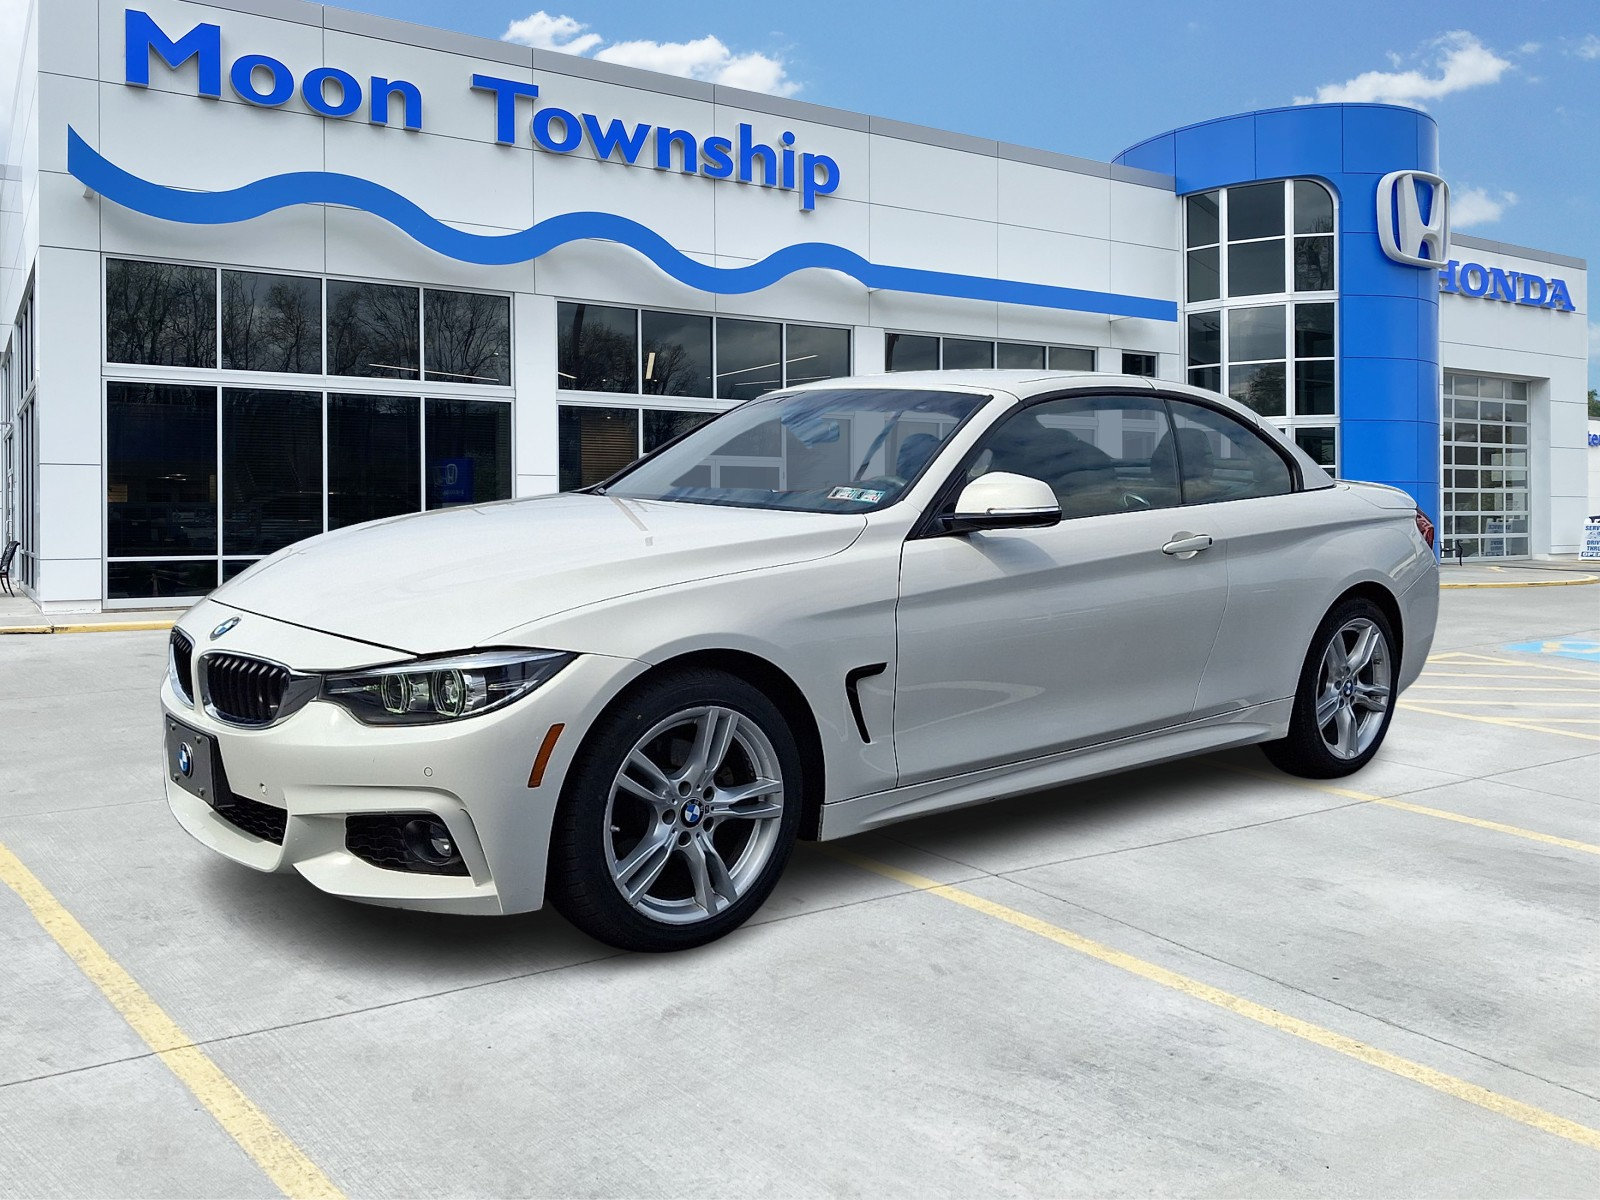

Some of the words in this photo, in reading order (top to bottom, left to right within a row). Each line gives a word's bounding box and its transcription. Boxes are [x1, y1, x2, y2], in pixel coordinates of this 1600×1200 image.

[124, 9, 422, 130] Moon
[470, 73, 840, 212] Township
[1438, 259, 1576, 311] HONDA
